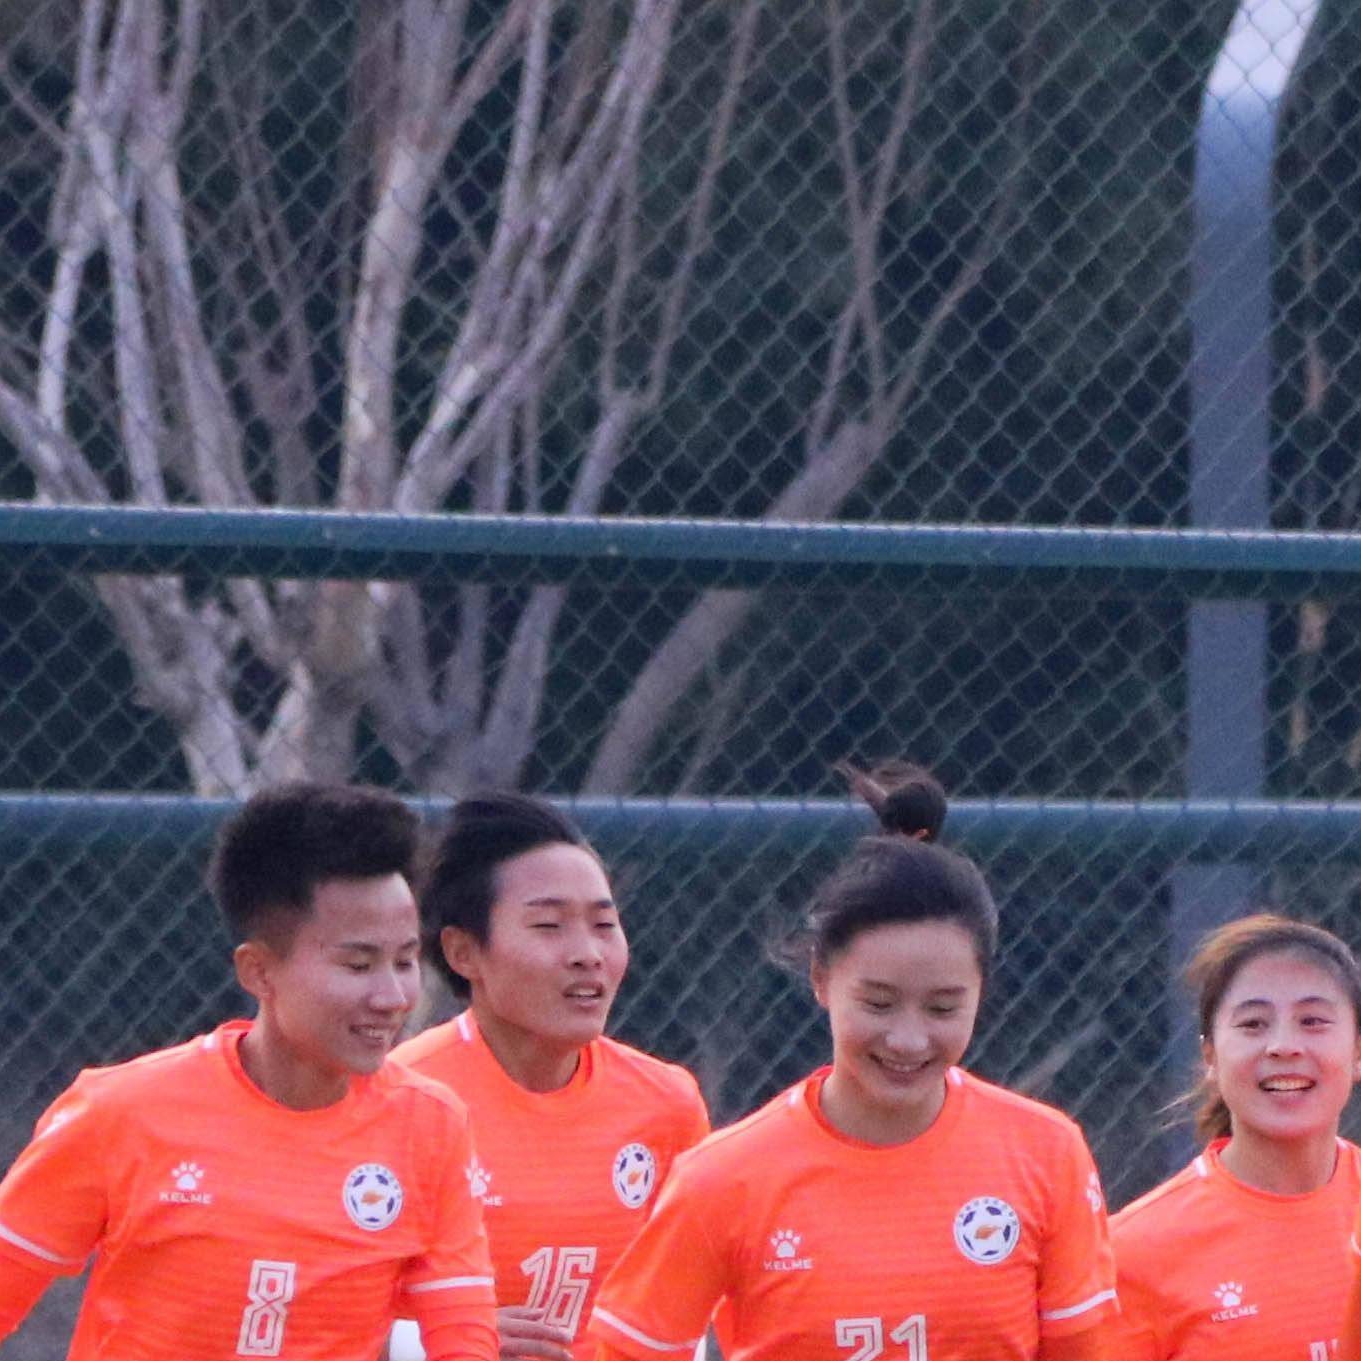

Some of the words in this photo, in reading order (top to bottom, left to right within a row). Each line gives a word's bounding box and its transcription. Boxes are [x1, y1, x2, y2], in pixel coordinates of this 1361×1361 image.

[159, 1191, 212, 1204] KELME
[763, 1257, 813, 1271] KELME
[520, 1246, 597, 1344] 16
[236, 1260, 295, 1356] 8
[1212, 1304, 1257, 1322] KELME
